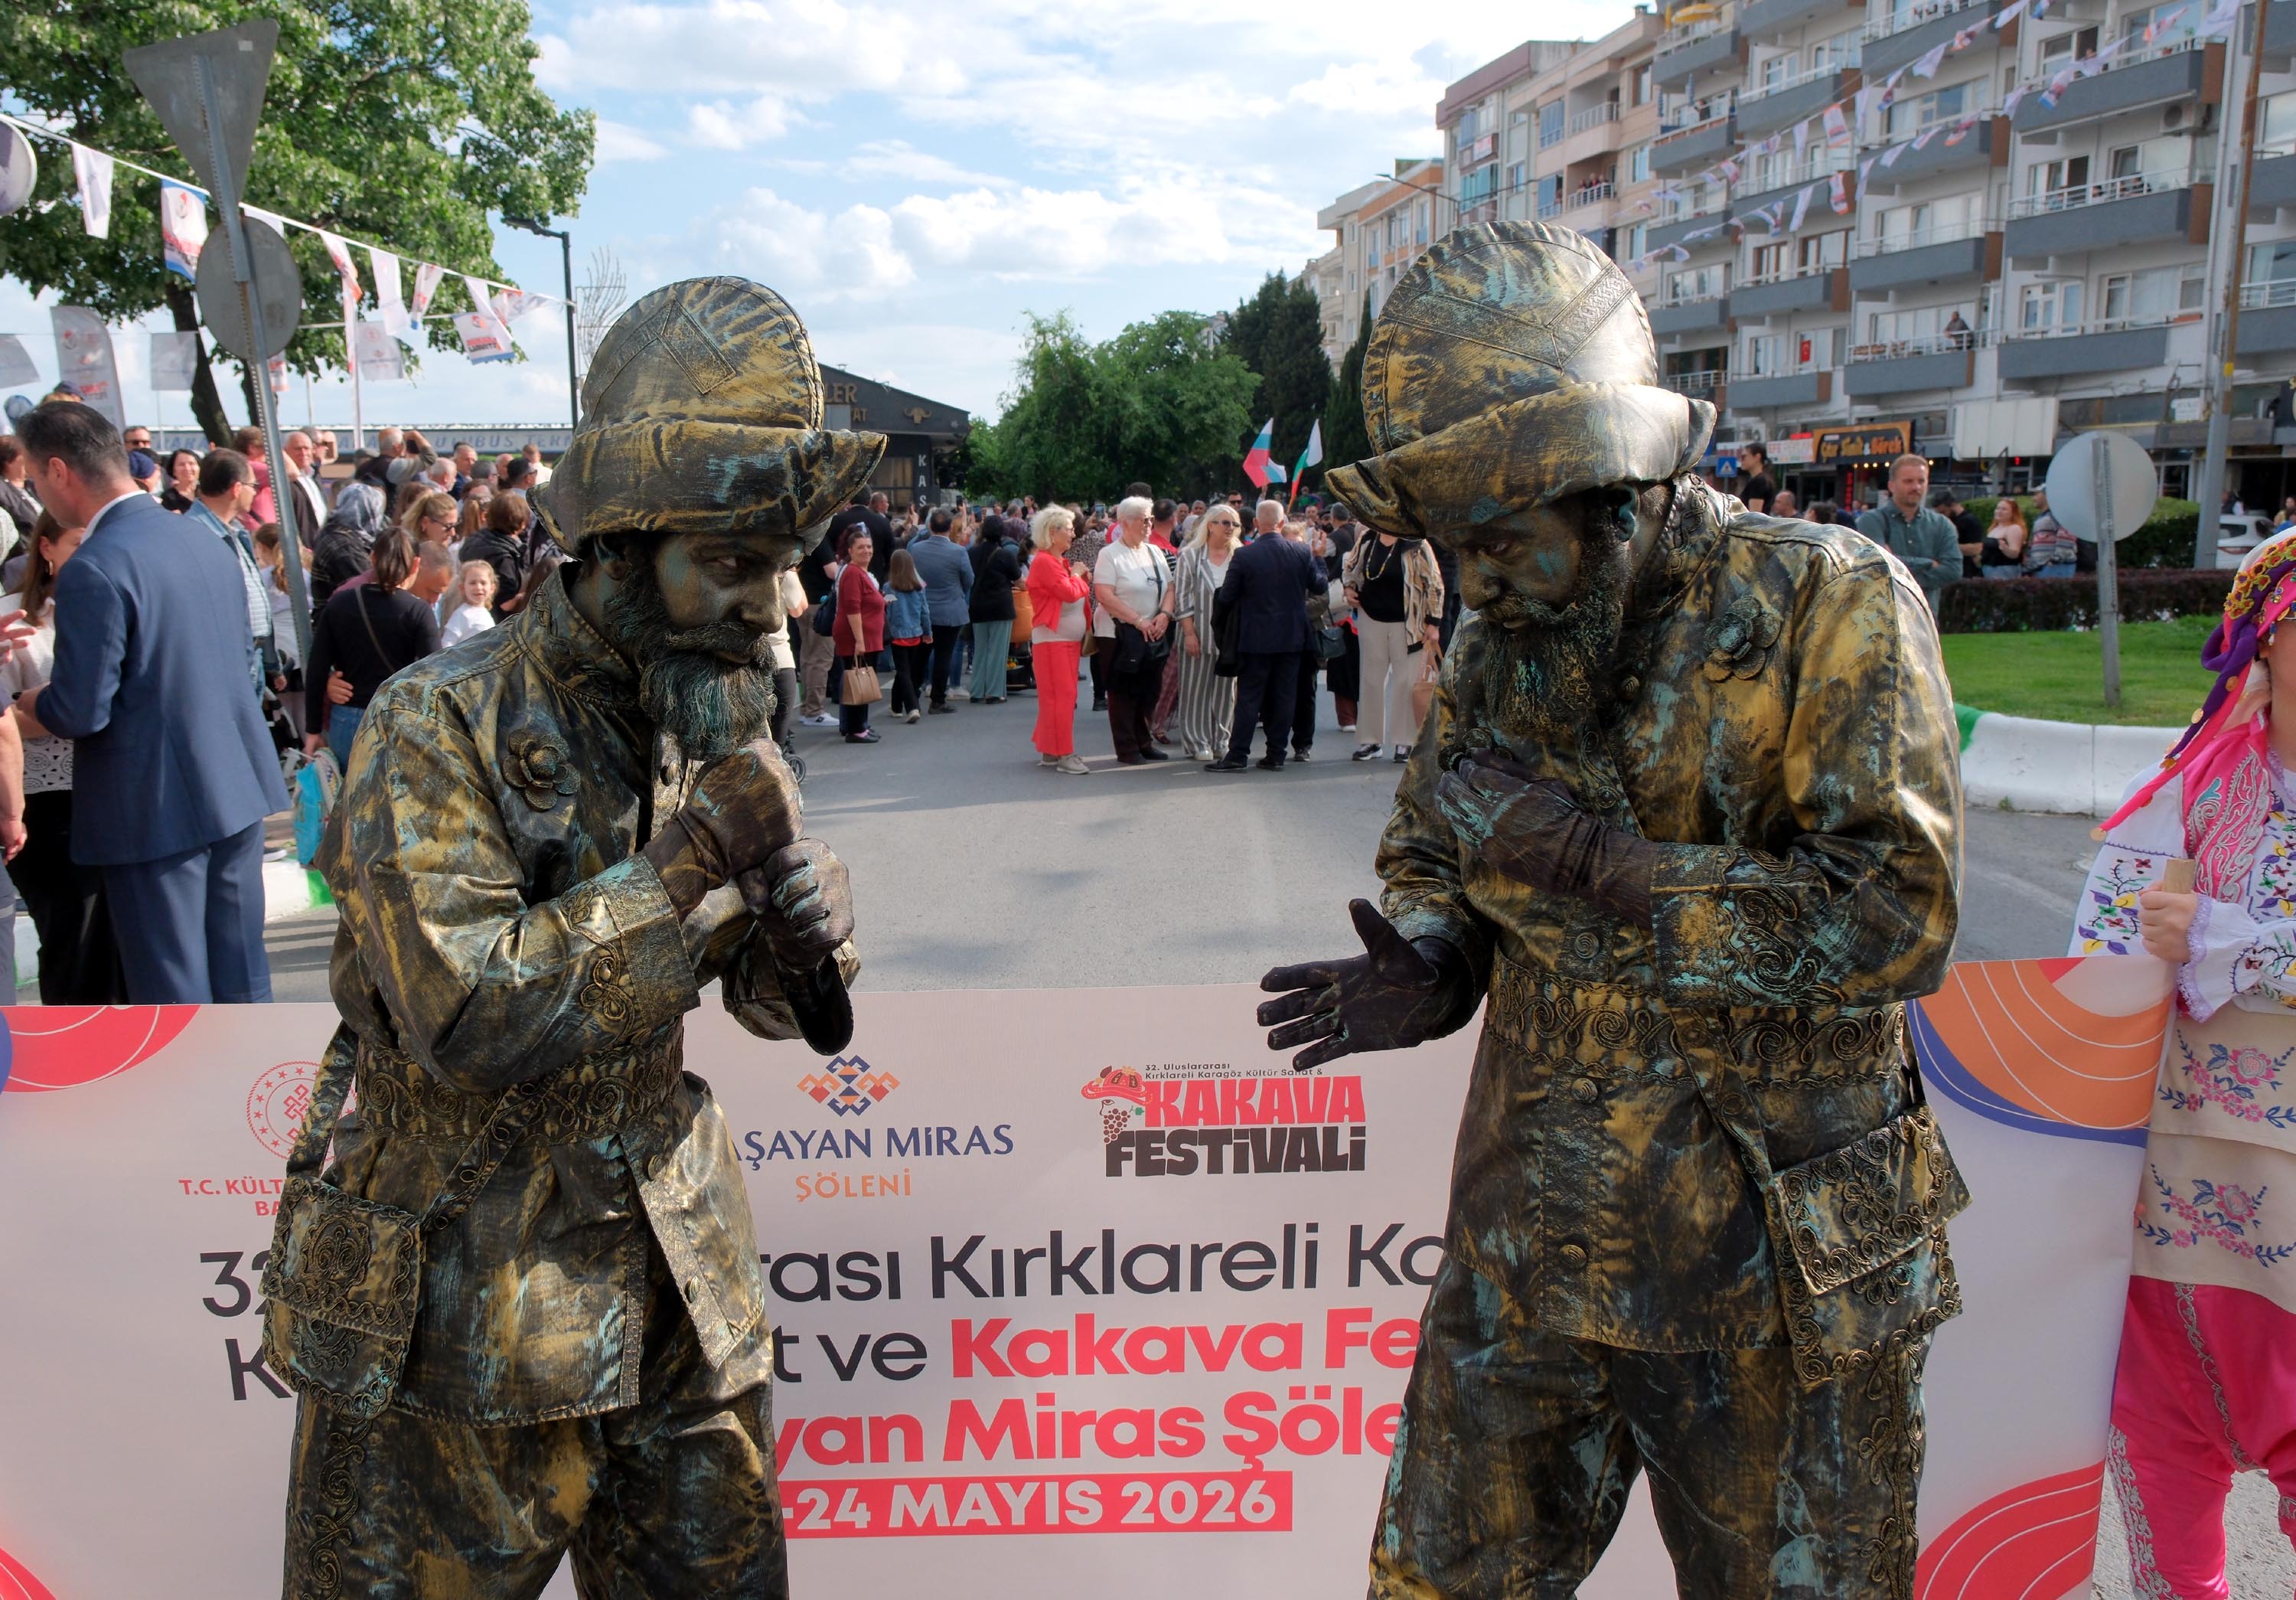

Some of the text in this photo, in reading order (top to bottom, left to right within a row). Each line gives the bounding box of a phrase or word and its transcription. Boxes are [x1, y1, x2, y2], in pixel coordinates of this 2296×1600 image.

[1145, 1071, 1194, 1079] Kırklareli
[1198, 1070, 1241, 1079] Karagöz
[1145, 1076, 1366, 1128] KAKAVA
[733, 1124, 1014, 1171] ŞAYAN MİRAS
[178, 1176, 285, 1195] T.C. KÜLT
[795, 1167, 912, 1202] ŞÖLENİ
[760, 1251, 902, 1302] ası
[930, 1222, 1319, 1301] Kırklareli
[816, 1332, 928, 1381] ve
[951, 1311, 1304, 1379] Kakava
[1325, 1308, 1420, 1368] Fe
[942, 1391, 1207, 1463] Miras
[888, 1479, 1104, 1528] MAYIS
[1120, 1479, 1276, 1524] 2026
